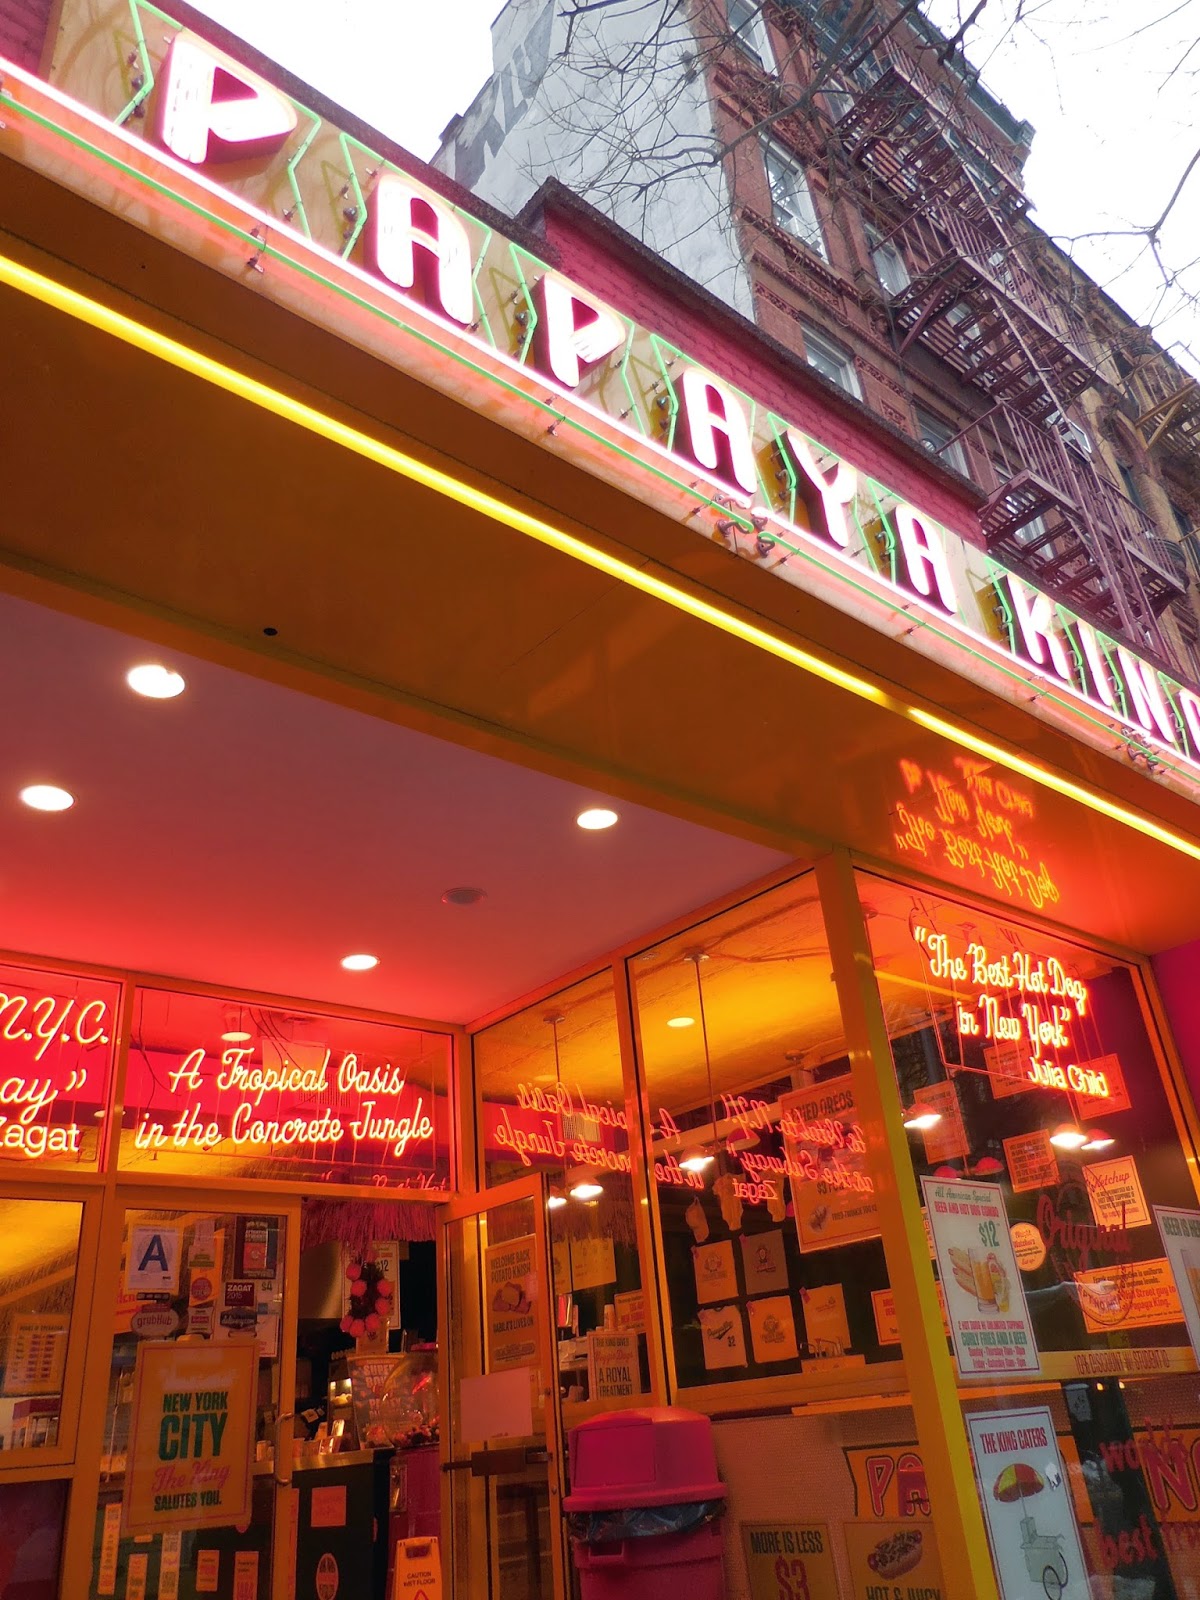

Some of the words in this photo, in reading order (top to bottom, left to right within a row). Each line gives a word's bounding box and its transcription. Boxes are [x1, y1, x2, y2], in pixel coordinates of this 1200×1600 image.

[158, 28, 957, 614] PAPAYA
[967, 943, 1014, 988] Best
[1012, 951, 1049, 994] Hot
[1048, 957, 1088, 1016] Dog
[956, 1001, 979, 1035] in
[978, 994, 1021, 1041] New
[168, 1048, 206, 1094] A
[217, 1048, 332, 1107] Tropical
[338, 1053, 405, 1095] Oasis
[1028, 1057, 1068, 1089] Julia
[1067, 1064, 1110, 1097] Child
[134, 1112, 168, 1150] in
[171, 1102, 222, 1147] the
[232, 1101, 345, 1146] Concrete
[350, 1097, 434, 1158] Jungle
[979, 1220, 1000, 1247] $12
[138, 1234, 168, 1272] A
[227, 1284, 252, 1292] ZAGAT
[606, 1366, 632, 1383] ROYAL
[162, 1393, 192, 1413] NEW
[194, 1391, 228, 1411] YORK
[158, 1413, 228, 1461] CITY
[979, 1432, 998, 1454] THE
[996, 1430, 1018, 1452] KING
[1017, 1426, 1048, 1450] CATERS
[154, 1491, 197, 1512] SALUTES
[750, 1531, 781, 1554] MORE
[783, 1531, 795, 1553] IS
[796, 1530, 824, 1553] LESS
[407, 1571, 432, 1579] CAUTION
